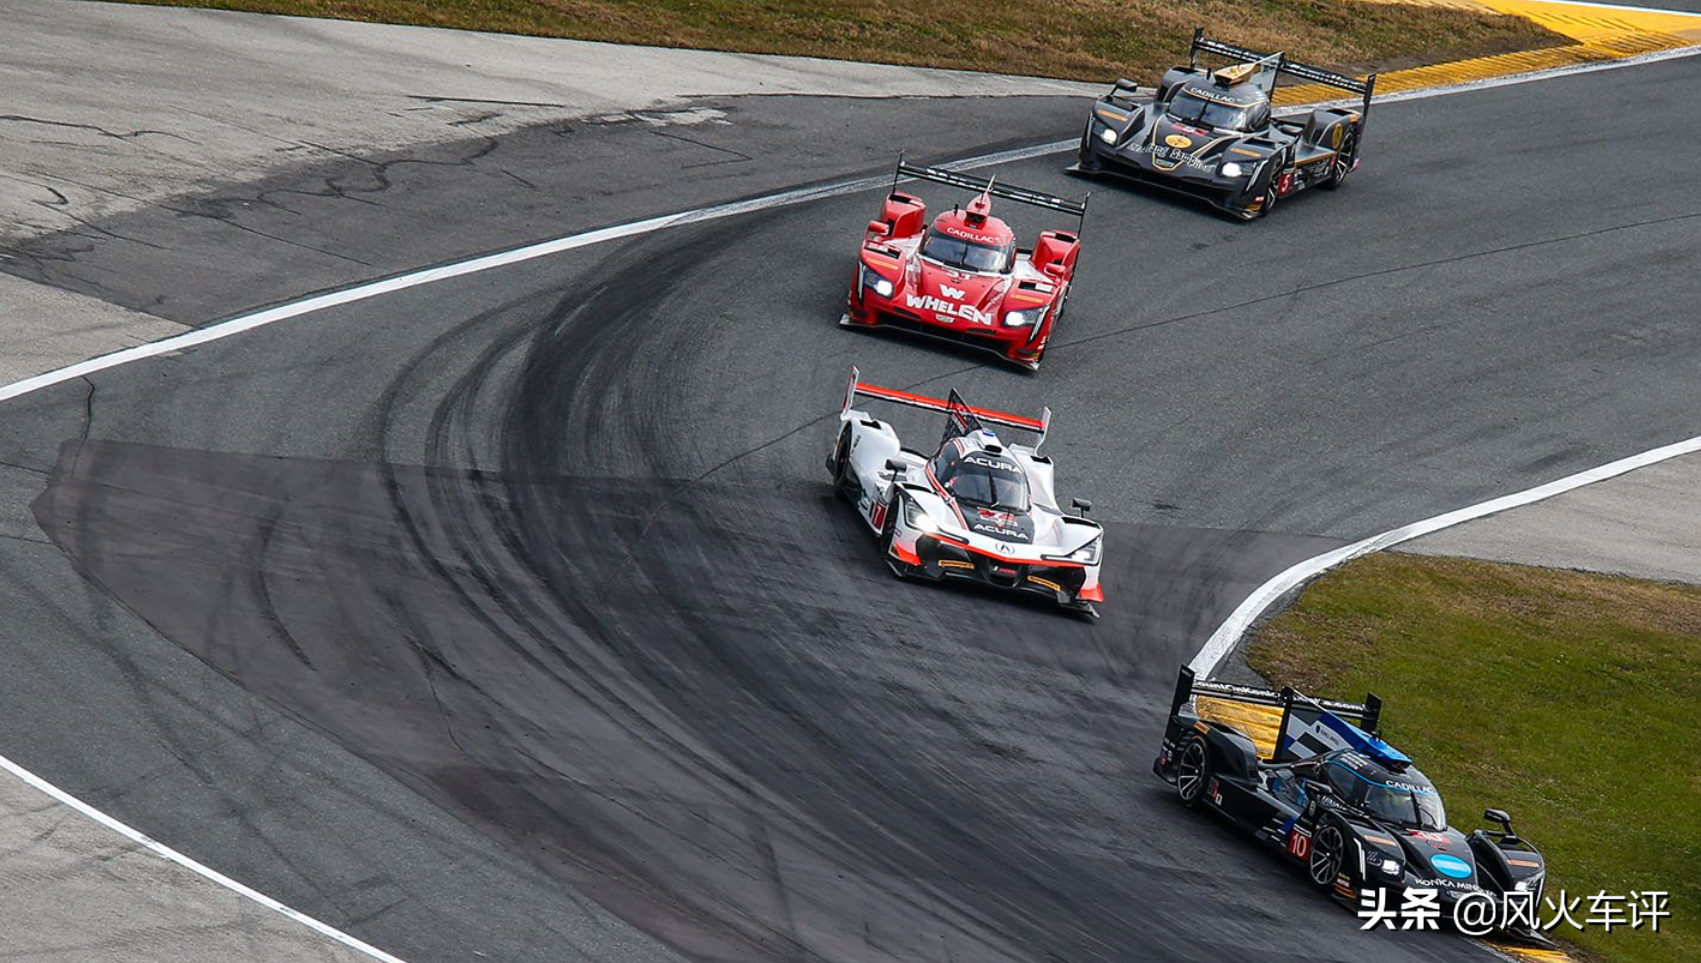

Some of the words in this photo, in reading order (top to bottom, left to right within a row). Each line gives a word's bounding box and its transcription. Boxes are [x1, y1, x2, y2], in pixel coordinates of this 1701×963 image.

[1189, 87, 1235, 103] CADILLAC
[1281, 174, 1291, 192] 5
[946, 226, 995, 243] CADILLAC
[940, 284, 966, 299] W
[906, 294, 993, 326] WHELEN
[963, 456, 1022, 475] ACURA
[973, 523, 1029, 540] ACURA
[1385, 780, 1436, 793] CADILLAC
[1291, 833, 1307, 857] 10
[1414, 878, 1456, 888] KONICA
